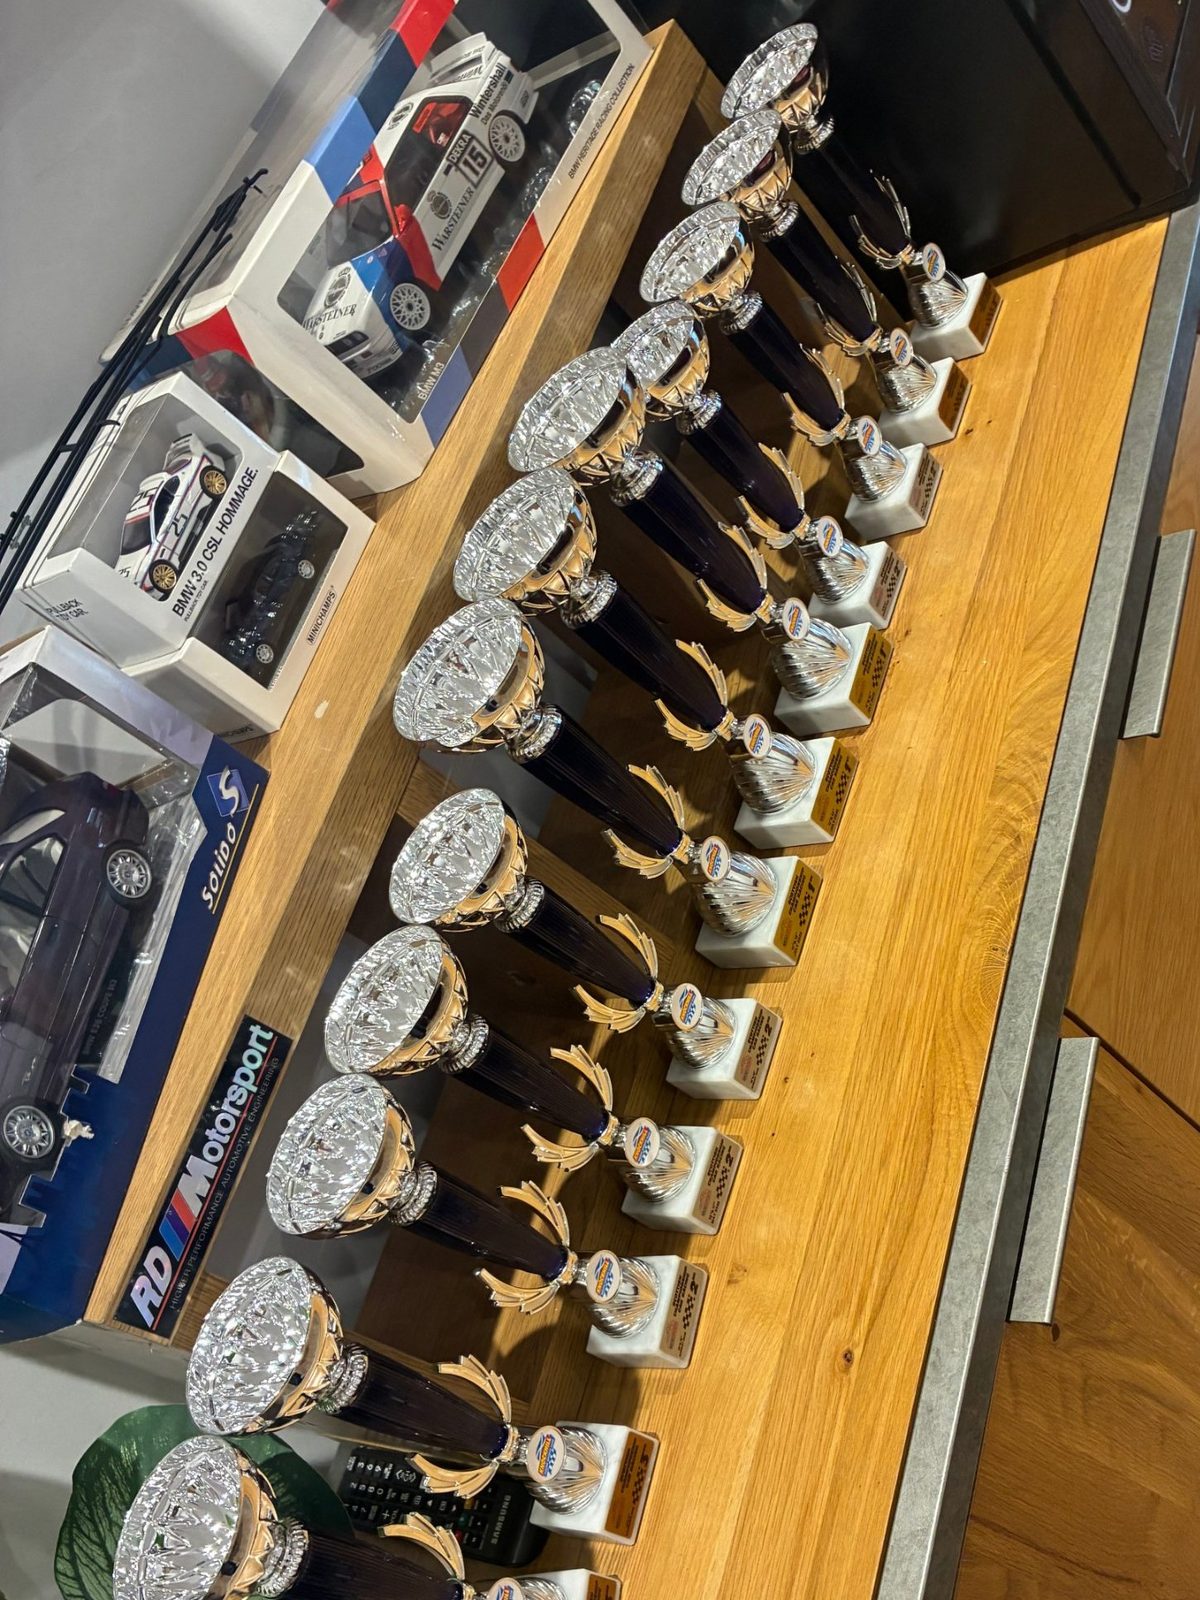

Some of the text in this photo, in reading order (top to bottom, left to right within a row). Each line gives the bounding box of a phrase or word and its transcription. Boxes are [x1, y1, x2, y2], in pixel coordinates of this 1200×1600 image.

[468, 63, 507, 118] Wintershall
[448, 134, 472, 162] DEKRA
[568, 63, 635, 179] BMW HERITAGE RACING COLLECTION
[462, 146, 487, 176] 15
[432, 186, 474, 250] WARSTEINER
[430, 362, 444, 376] M3
[172, 467, 258, 616] BMW 3.0 CSL HOMMAGE.
[308, 591, 336, 644] MINICHAMPS
[130, 1023, 274, 1328] RD Motorsport
[188, 1191, 224, 1270] PERFORMANCE
[221, 1124, 252, 1187] AUTOMOTIVE
[249, 1057, 280, 1122] ENGINEERING
[490, 1494, 512, 1544] SAMSUNG
